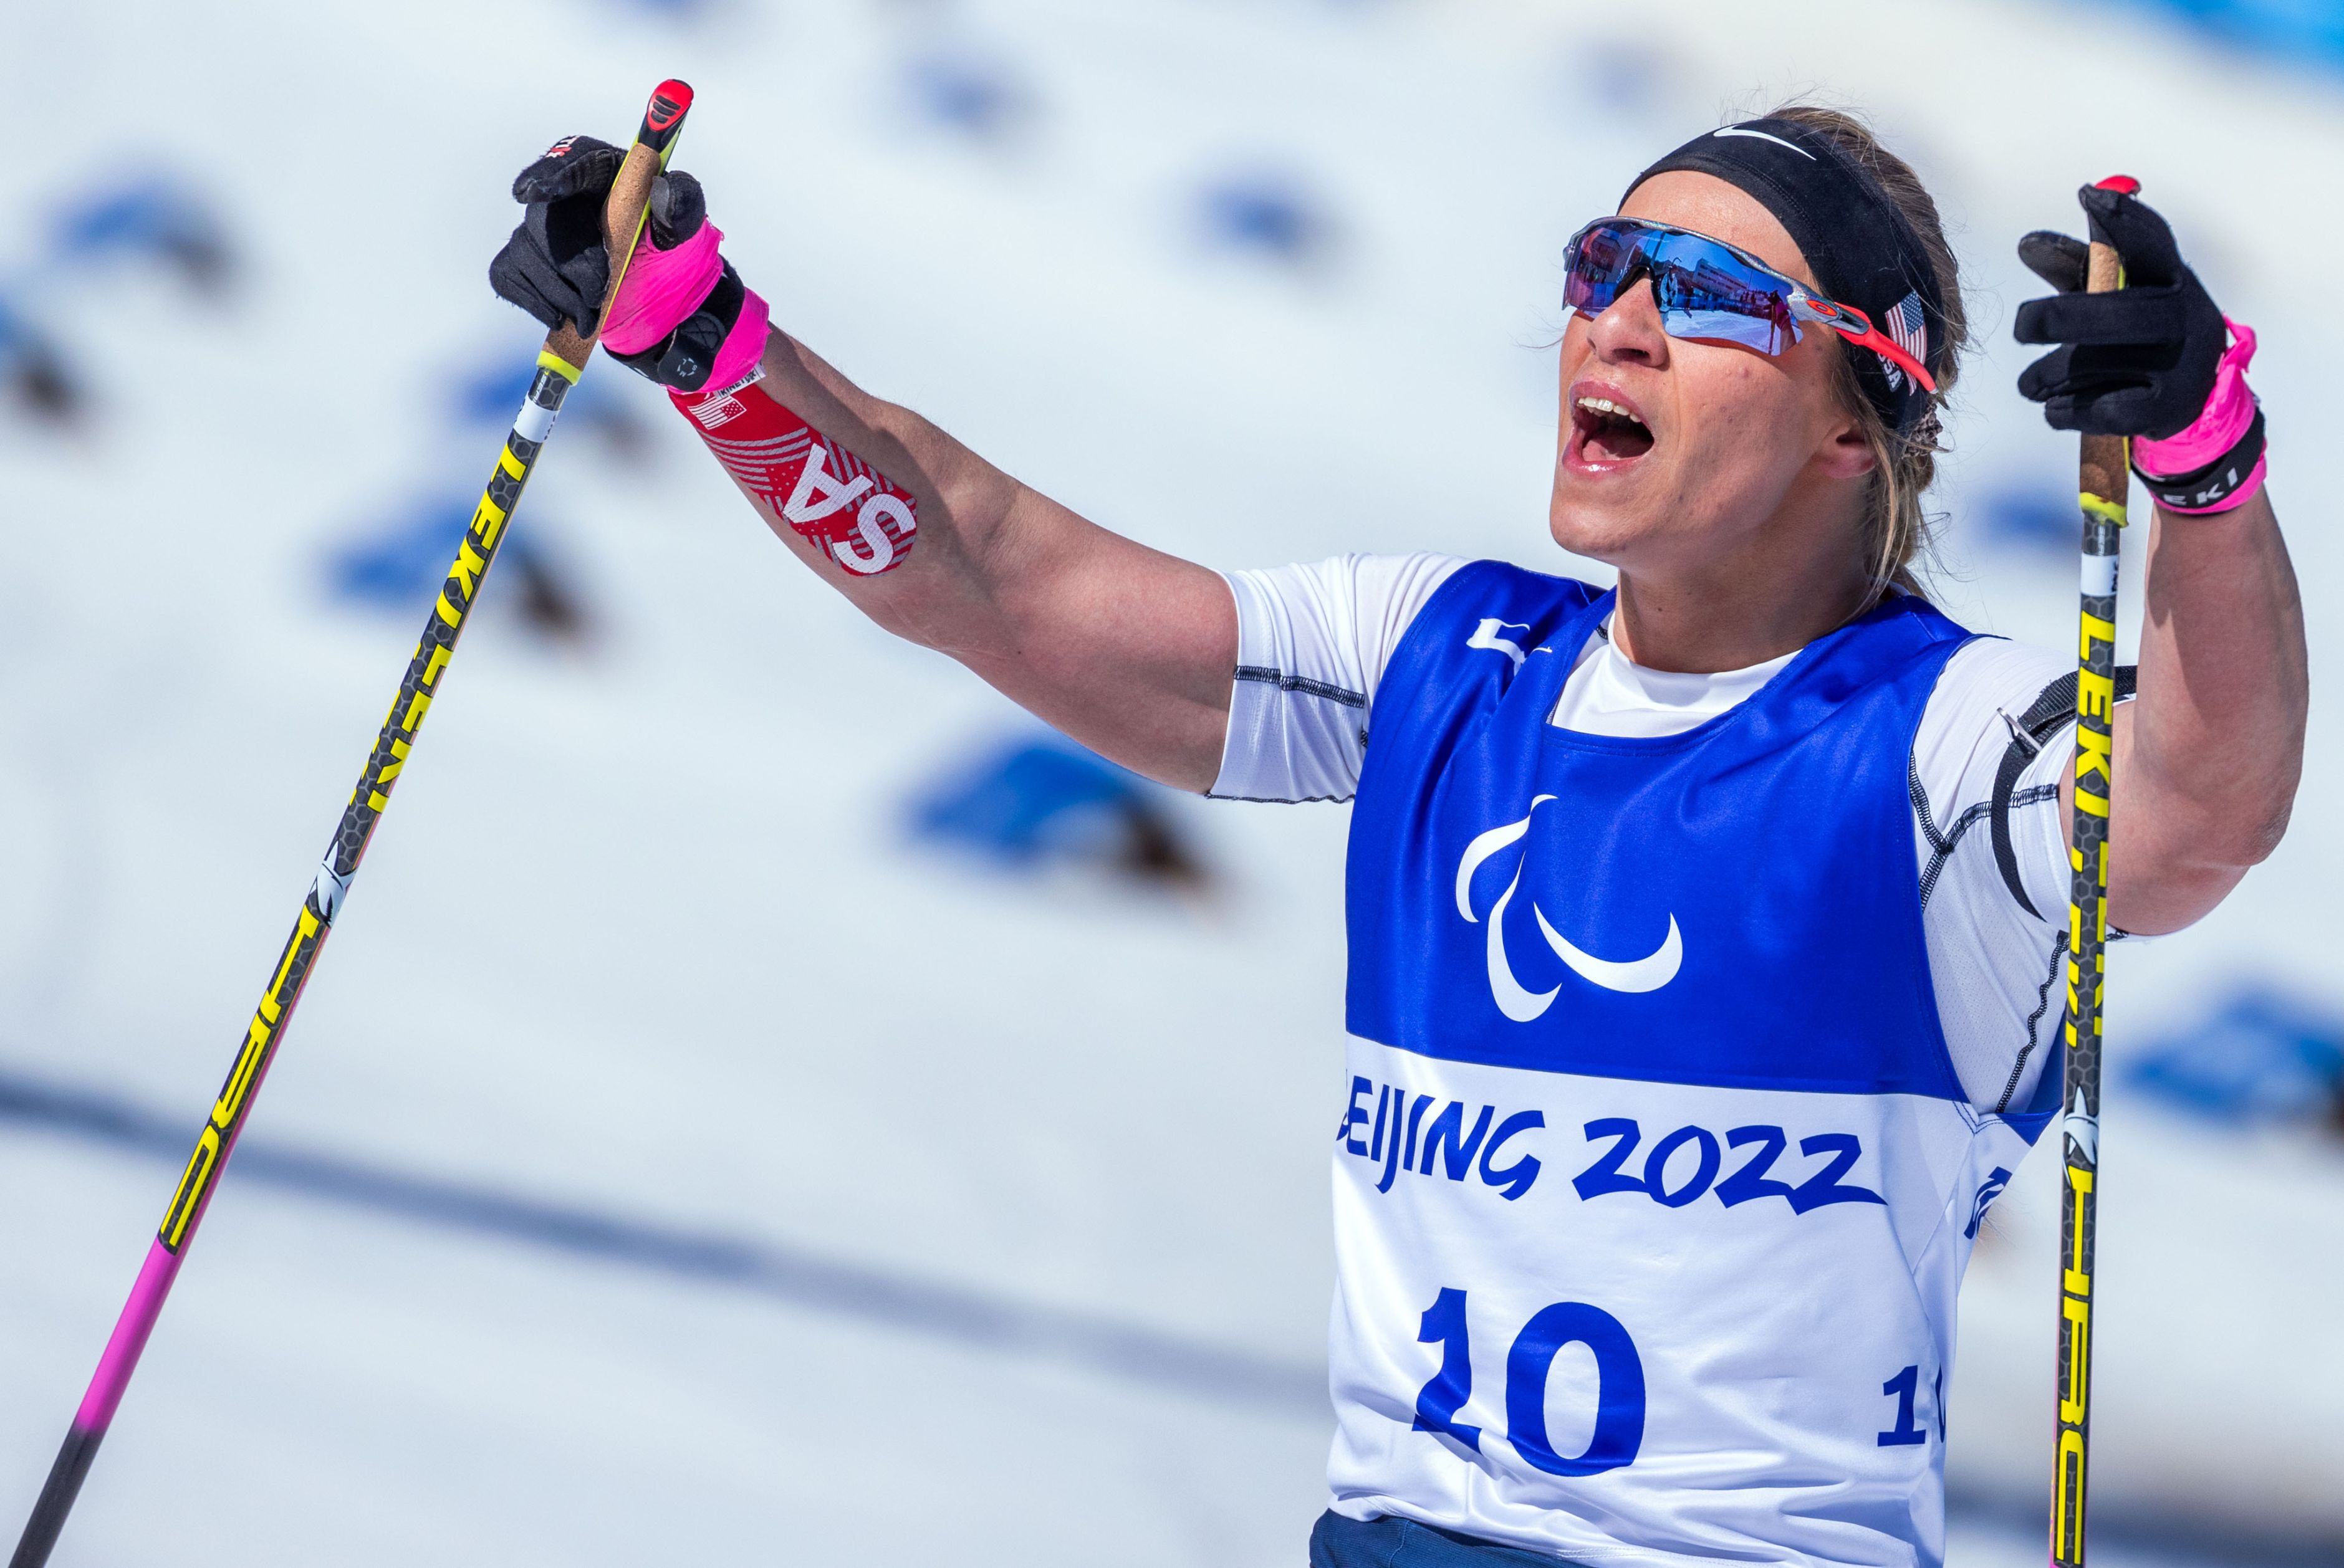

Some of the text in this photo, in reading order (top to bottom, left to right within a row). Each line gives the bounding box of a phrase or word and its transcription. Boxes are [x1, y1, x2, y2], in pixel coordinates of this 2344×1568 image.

[436, 444, 527, 629] LEKI
[2074, 611, 2116, 819] LEKI
[160, 905, 320, 1248] HRC
[1572, 1117, 1888, 1216] 2022
[1411, 1287, 1646, 1478] 10
[2056, 1164, 2093, 1566] HRC
